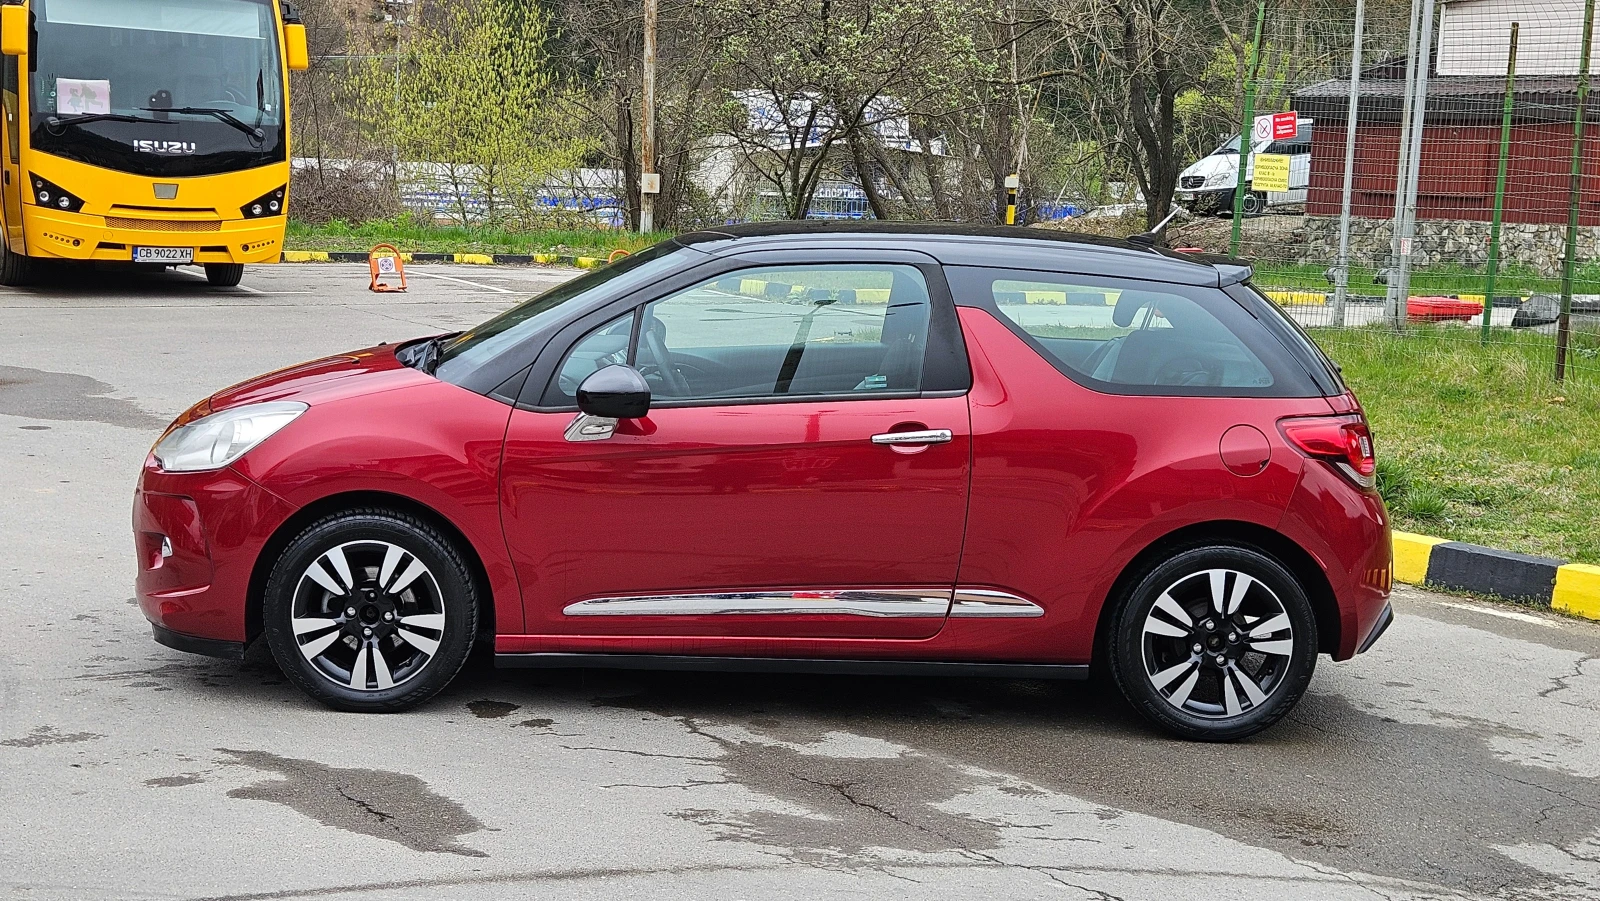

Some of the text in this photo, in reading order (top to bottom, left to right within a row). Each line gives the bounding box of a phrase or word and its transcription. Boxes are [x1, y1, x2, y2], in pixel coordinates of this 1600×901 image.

[133, 139, 196, 154] ISUZU
[139, 248, 192, 259] CB 9022 XH
